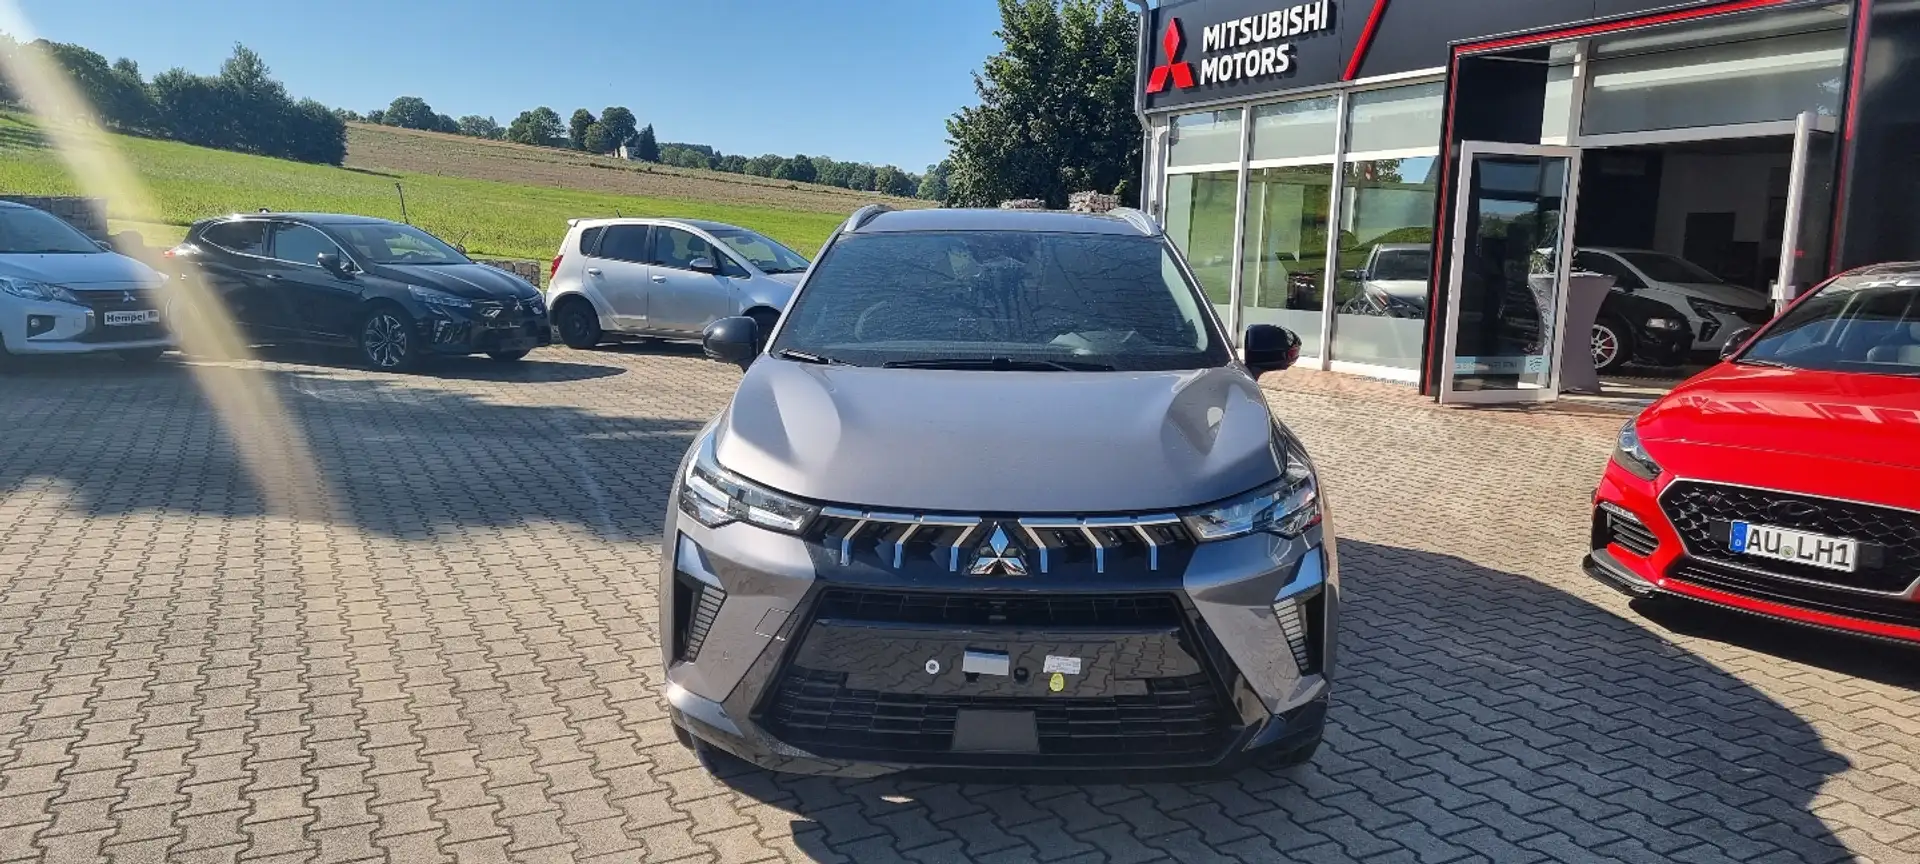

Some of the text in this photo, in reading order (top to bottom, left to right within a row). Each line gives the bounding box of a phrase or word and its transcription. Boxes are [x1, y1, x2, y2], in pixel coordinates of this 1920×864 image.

[1202, 0, 1328, 52] MITSUBISHI
[1200, 43, 1290, 85] MOTORS
[106, 312, 145, 324] Hempel
[1747, 528, 1850, 566] AU LH1
